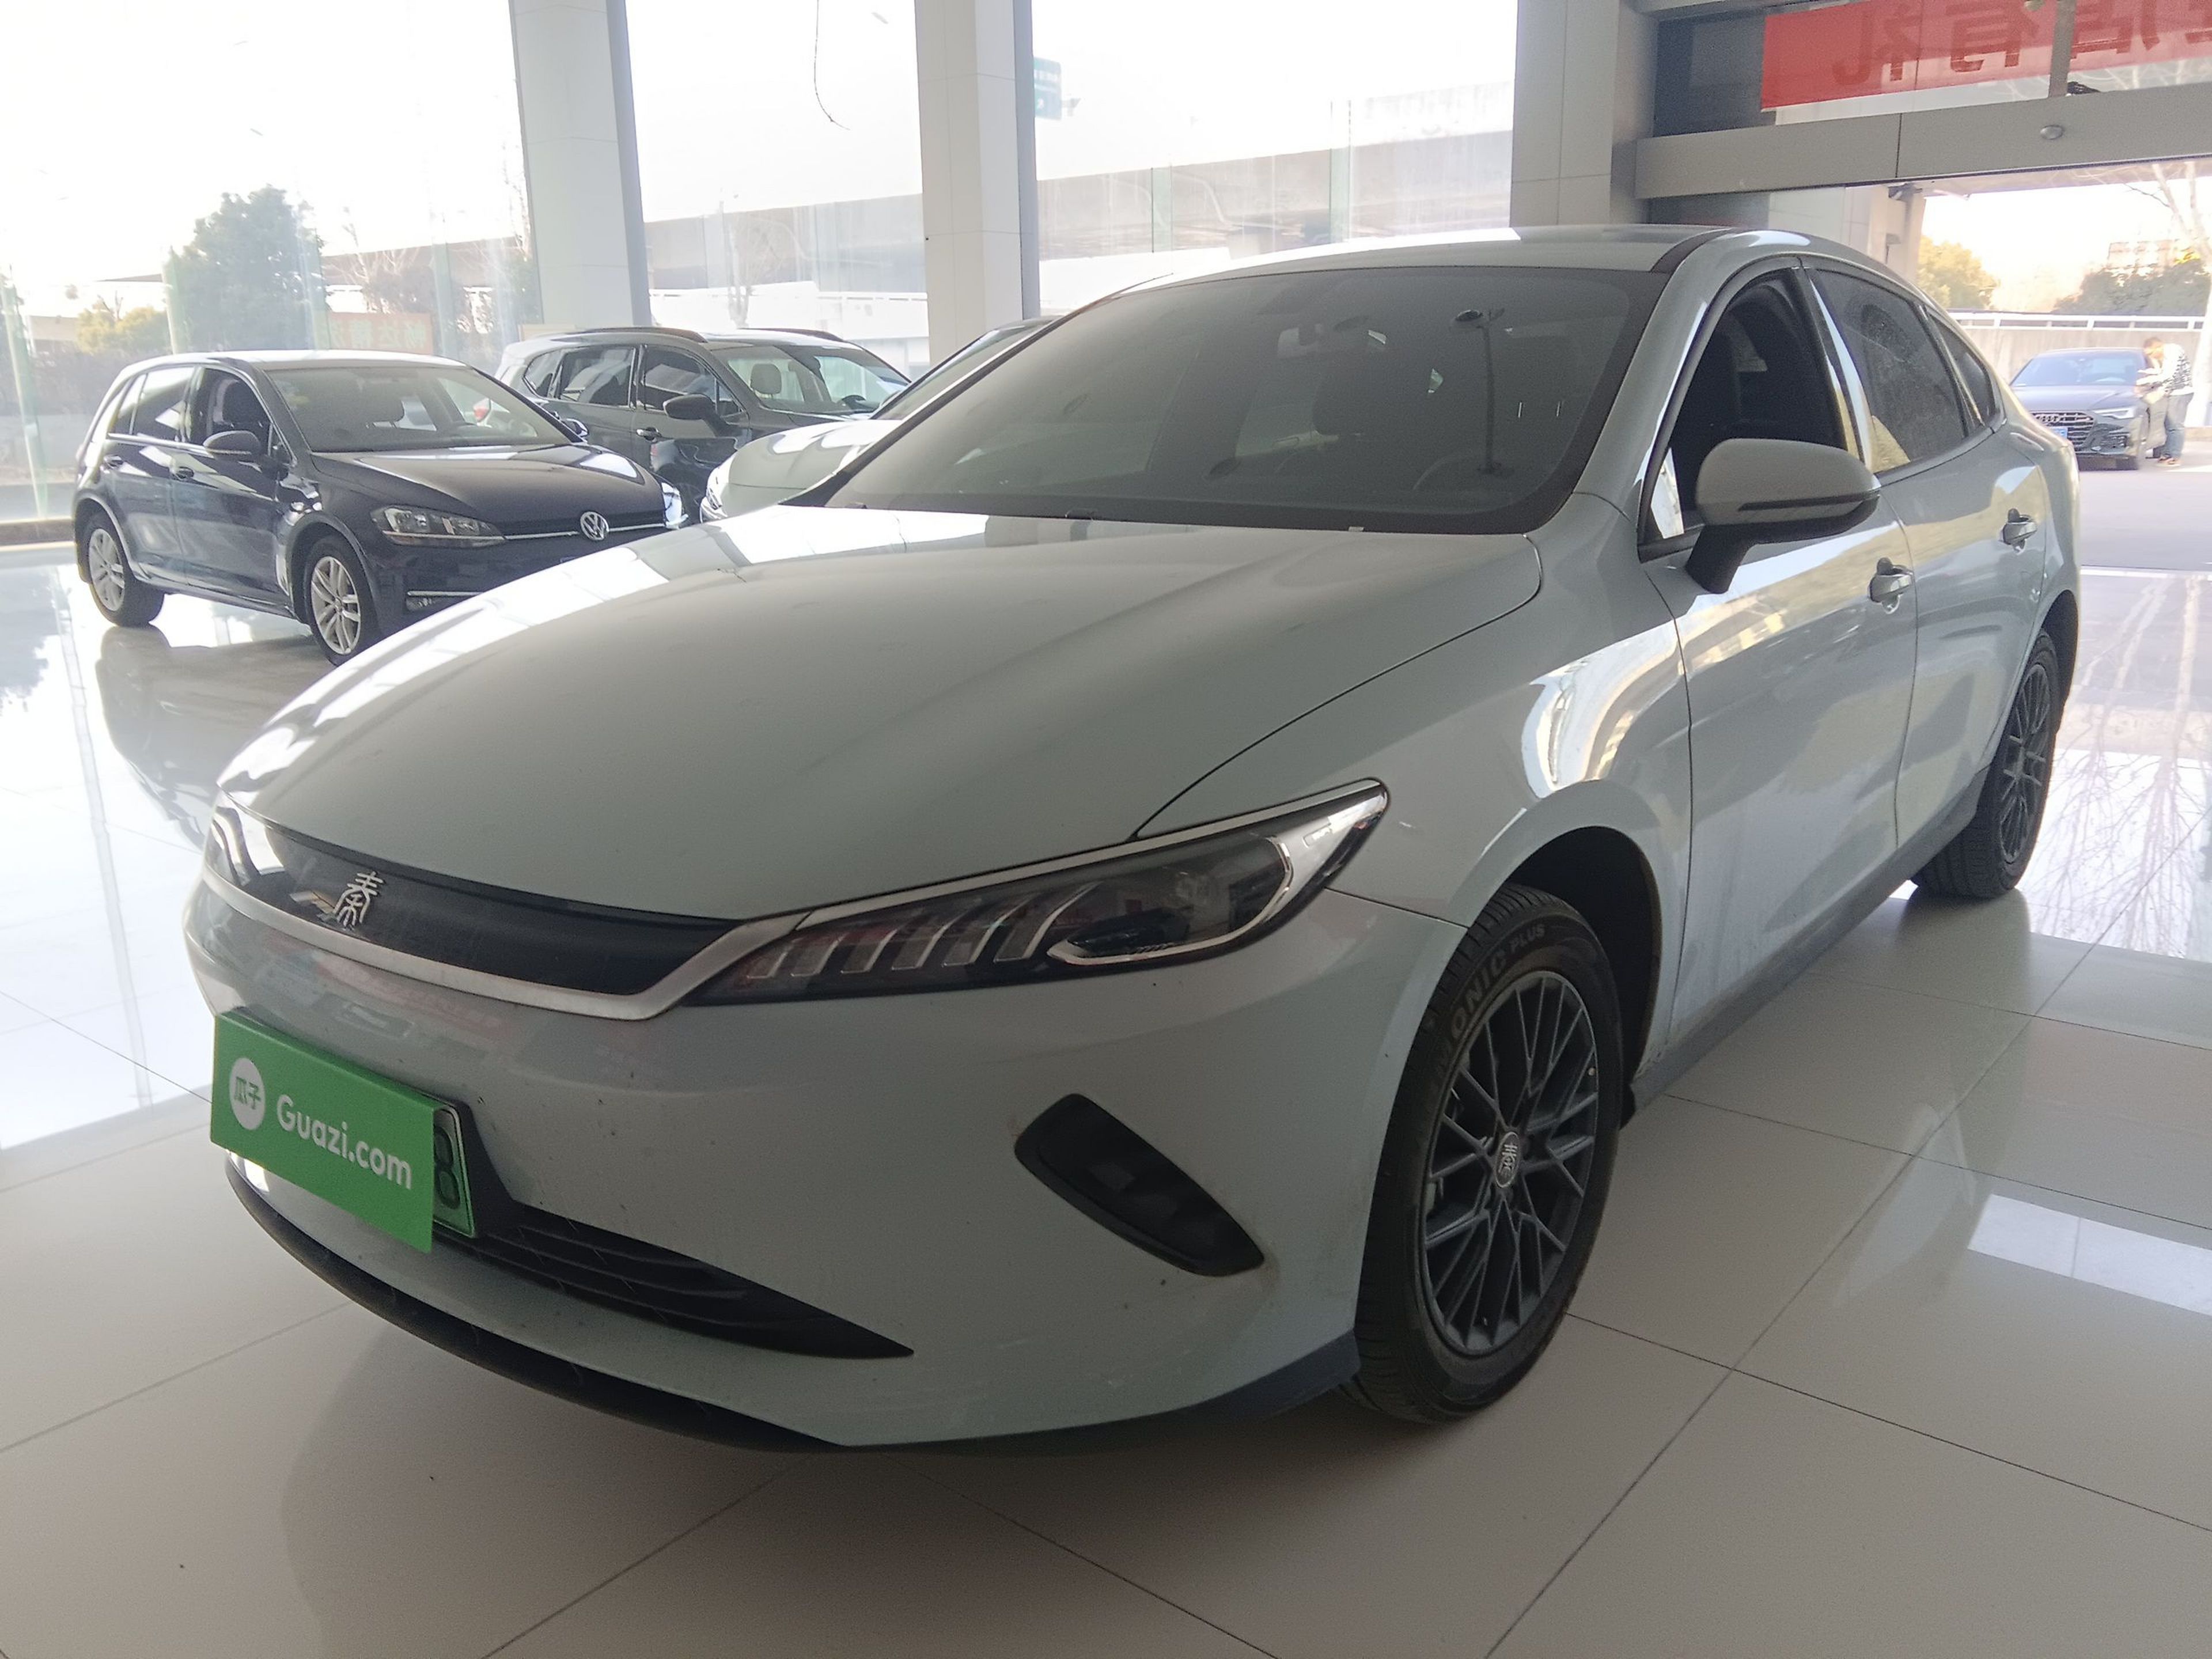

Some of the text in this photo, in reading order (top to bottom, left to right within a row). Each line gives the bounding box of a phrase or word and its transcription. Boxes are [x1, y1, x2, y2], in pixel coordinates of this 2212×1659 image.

[1509, 923, 1546, 953] PLUS
[234, 1076, 261, 1109] 瓜子
[276, 1094, 412, 1190] Guazi.com
